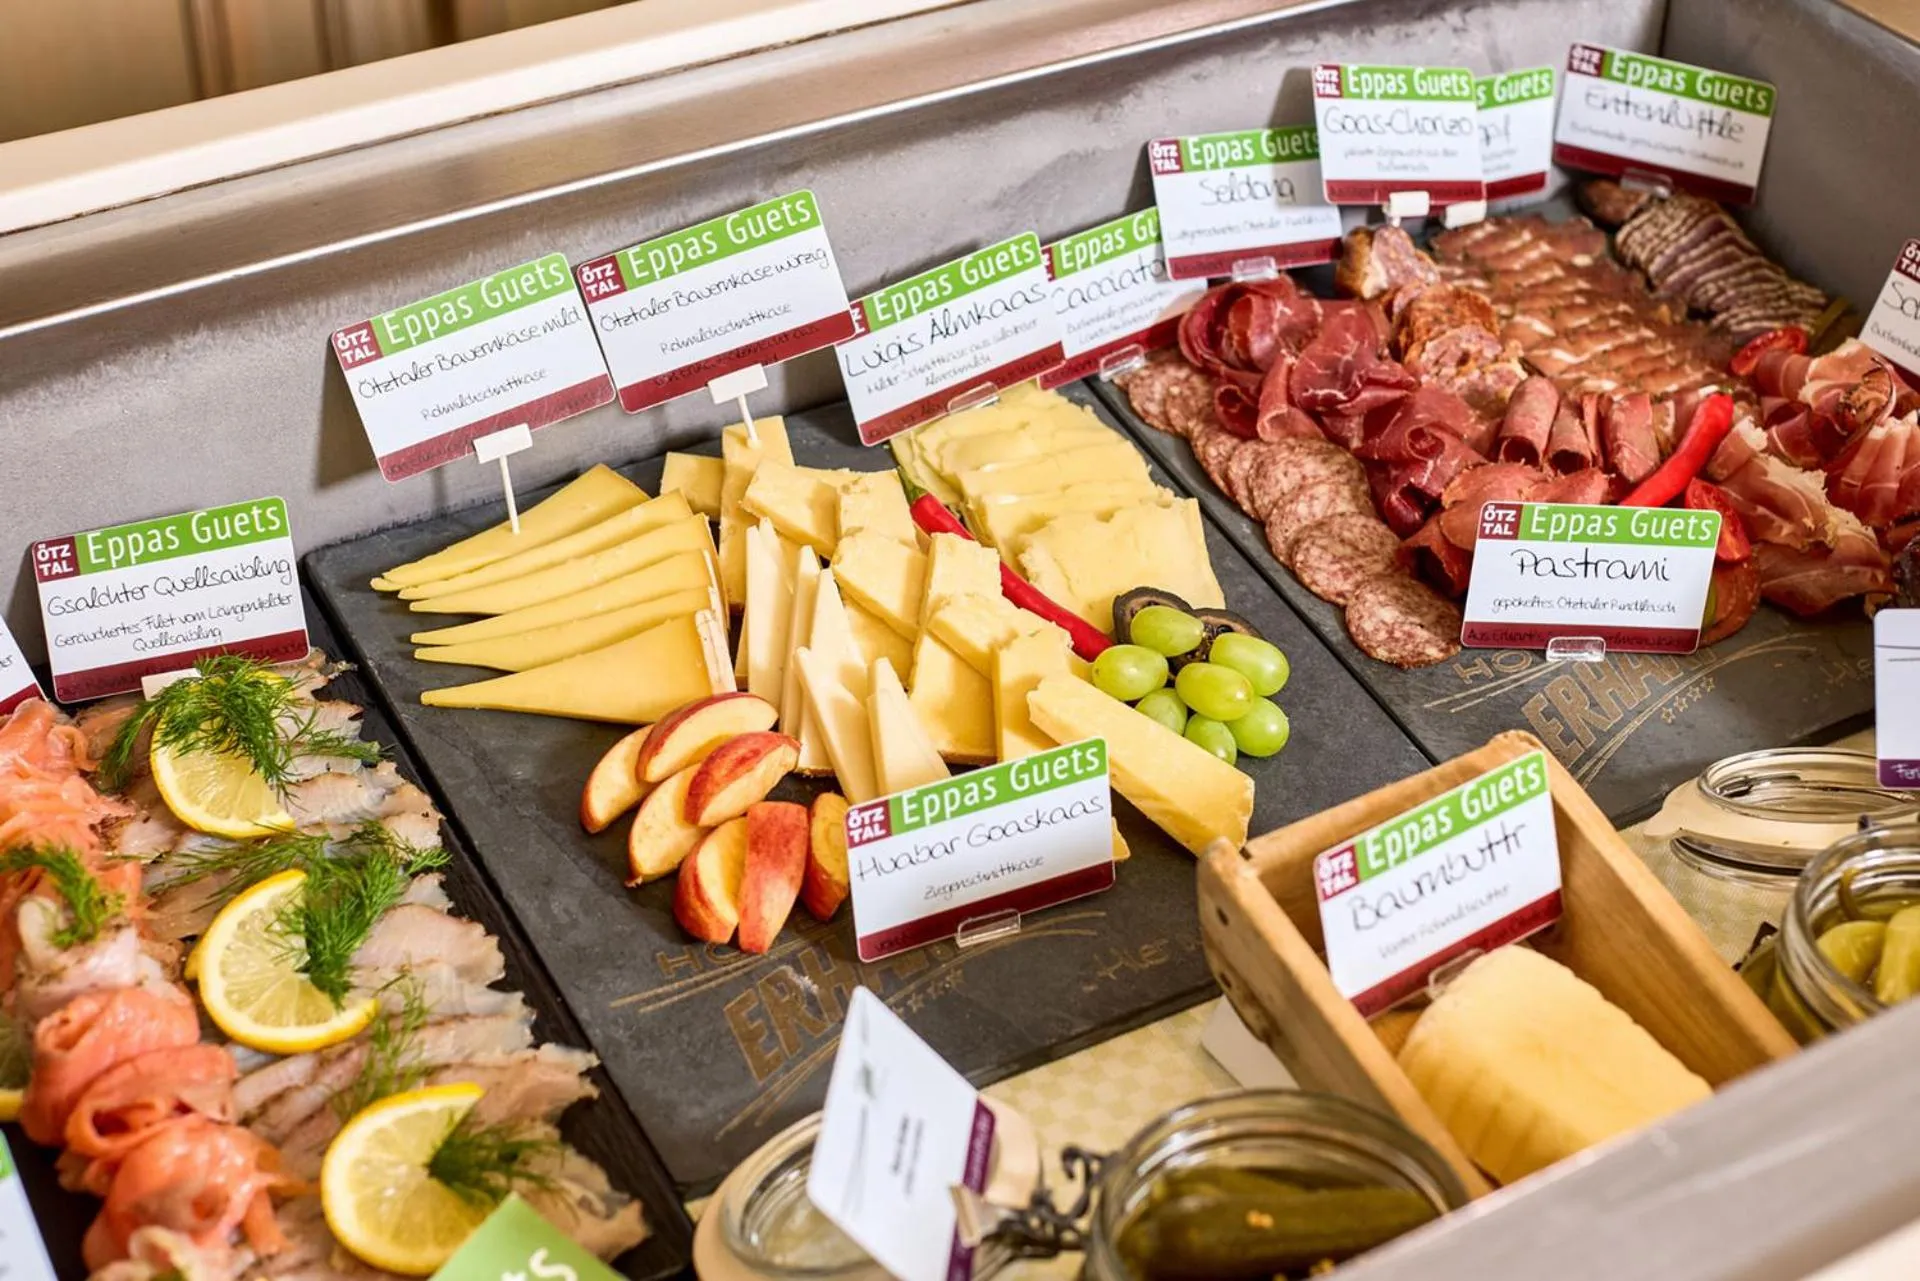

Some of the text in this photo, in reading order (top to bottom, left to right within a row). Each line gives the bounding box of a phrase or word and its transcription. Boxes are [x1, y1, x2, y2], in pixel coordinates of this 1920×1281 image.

[1347, 66, 1407, 99] Eppas
[1413, 67, 1472, 97] Guets
[1493, 69, 1552, 102] Guets
[1609, 48, 1769, 112] Eppas Guets
[1153, 157, 1181, 172] TAL
[1188, 137, 1256, 171] Eppas
[626, 198, 812, 281] Eppas Guets
[1059, 227, 1127, 272] Eppas
[581, 262, 616, 286] ÖTZ
[585, 280, 621, 299] TAL
[872, 272, 954, 323] Eppas
[959, 239, 1036, 287] Guets
[382, 261, 566, 346] Eppas Guets
[541, 305, 583, 337] mild
[336, 328, 371, 351] ÖTZ
[341, 345, 377, 365] TAL
[1482, 522, 1514, 536] TAL
[1484, 504, 1517, 522] ÖTZ
[1530, 505, 1714, 543] Eppas Guets
[36, 541, 72, 562] ÖTZ
[85, 504, 282, 568] Eppas Guets
[38, 561, 74, 577] TAL
[153, 555, 294, 596] Quellsaibling
[1510, 546, 1671, 582] Pastrami
[132, 626, 223, 653] Quellsaibling
[900, 745, 1100, 827] Eppas Guets
[848, 804, 885, 827] ÖTZ
[1363, 759, 1541, 872] Eppas Guets
[849, 824, 887, 844] TAL
[856, 795, 1105, 883] Huabar Goaskaas
